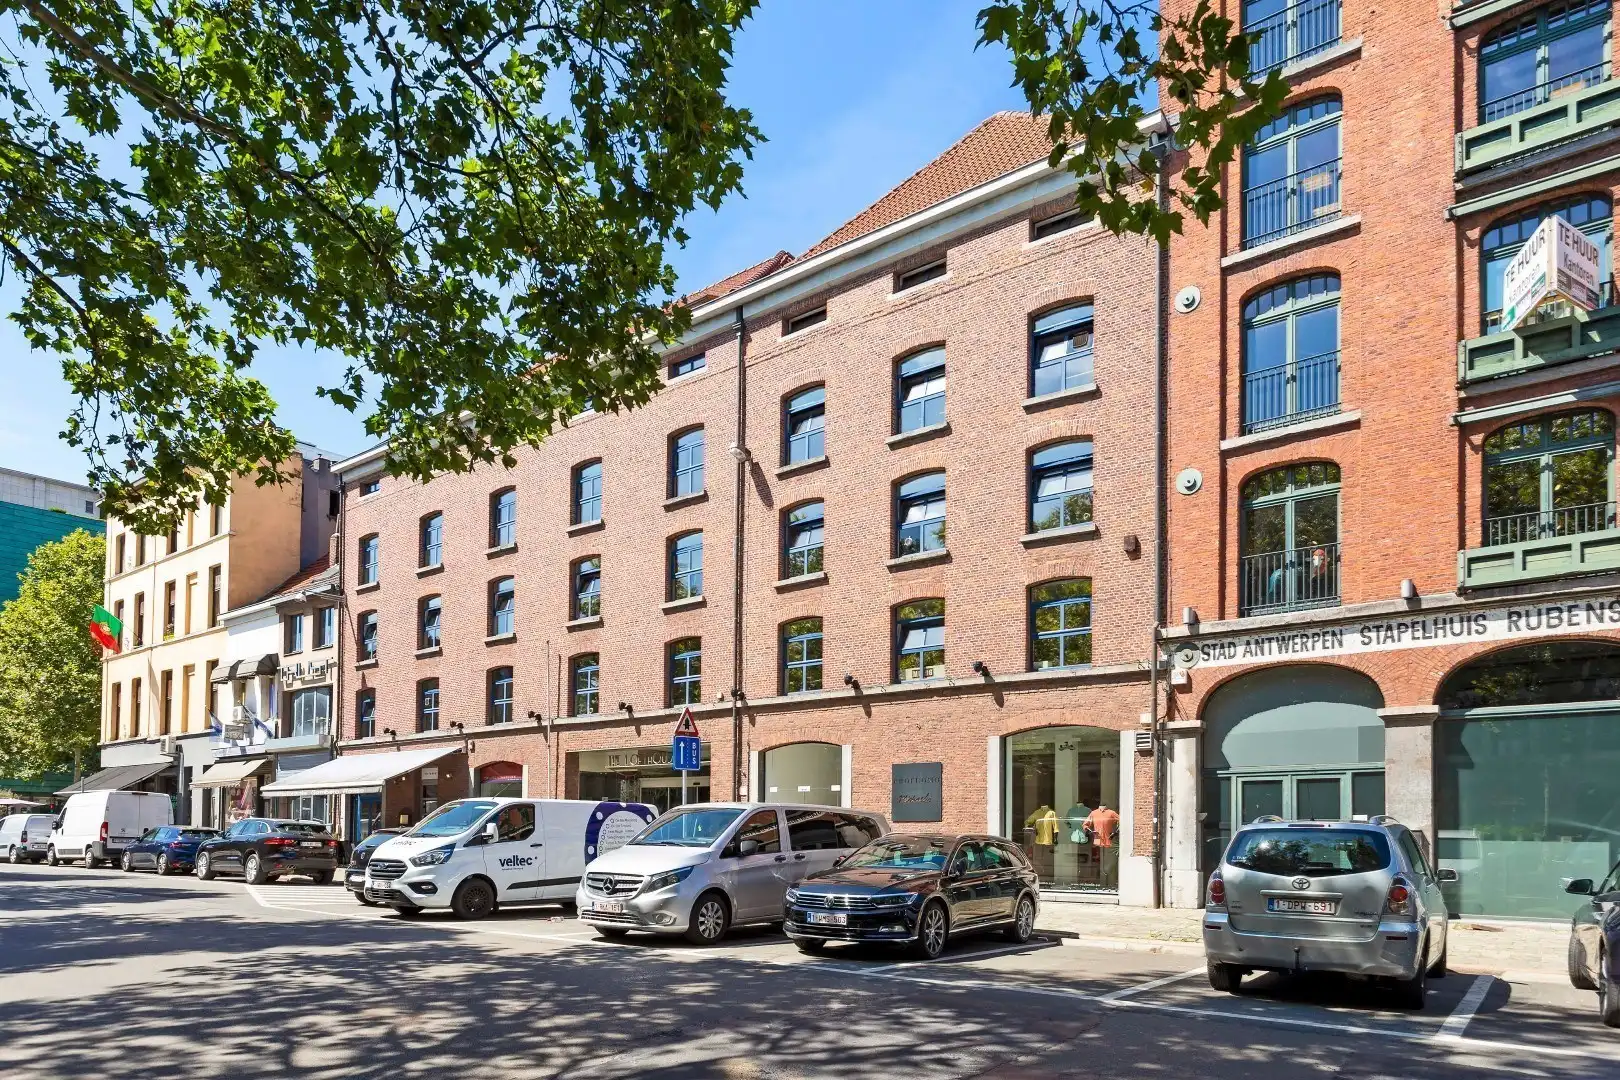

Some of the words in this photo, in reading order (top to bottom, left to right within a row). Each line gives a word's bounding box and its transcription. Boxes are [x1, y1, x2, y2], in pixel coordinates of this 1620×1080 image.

[1505, 263, 1515, 288] TE
[1517, 228, 1546, 274] HUUR
[1557, 221, 1571, 247] TE
[1571, 232, 1599, 267] HUUR
[1563, 251, 1594, 287] Kantoren
[1201, 640, 1237, 662] STAD
[1243, 629, 1343, 658] ANTWERPEN
[1360, 613, 1487, 645] STAPELHUIS
[1506, 600, 1620, 632] RUBENS
[498, 854, 533, 868] veltec
[1275, 899, 1333, 912] 1-DPW-691
